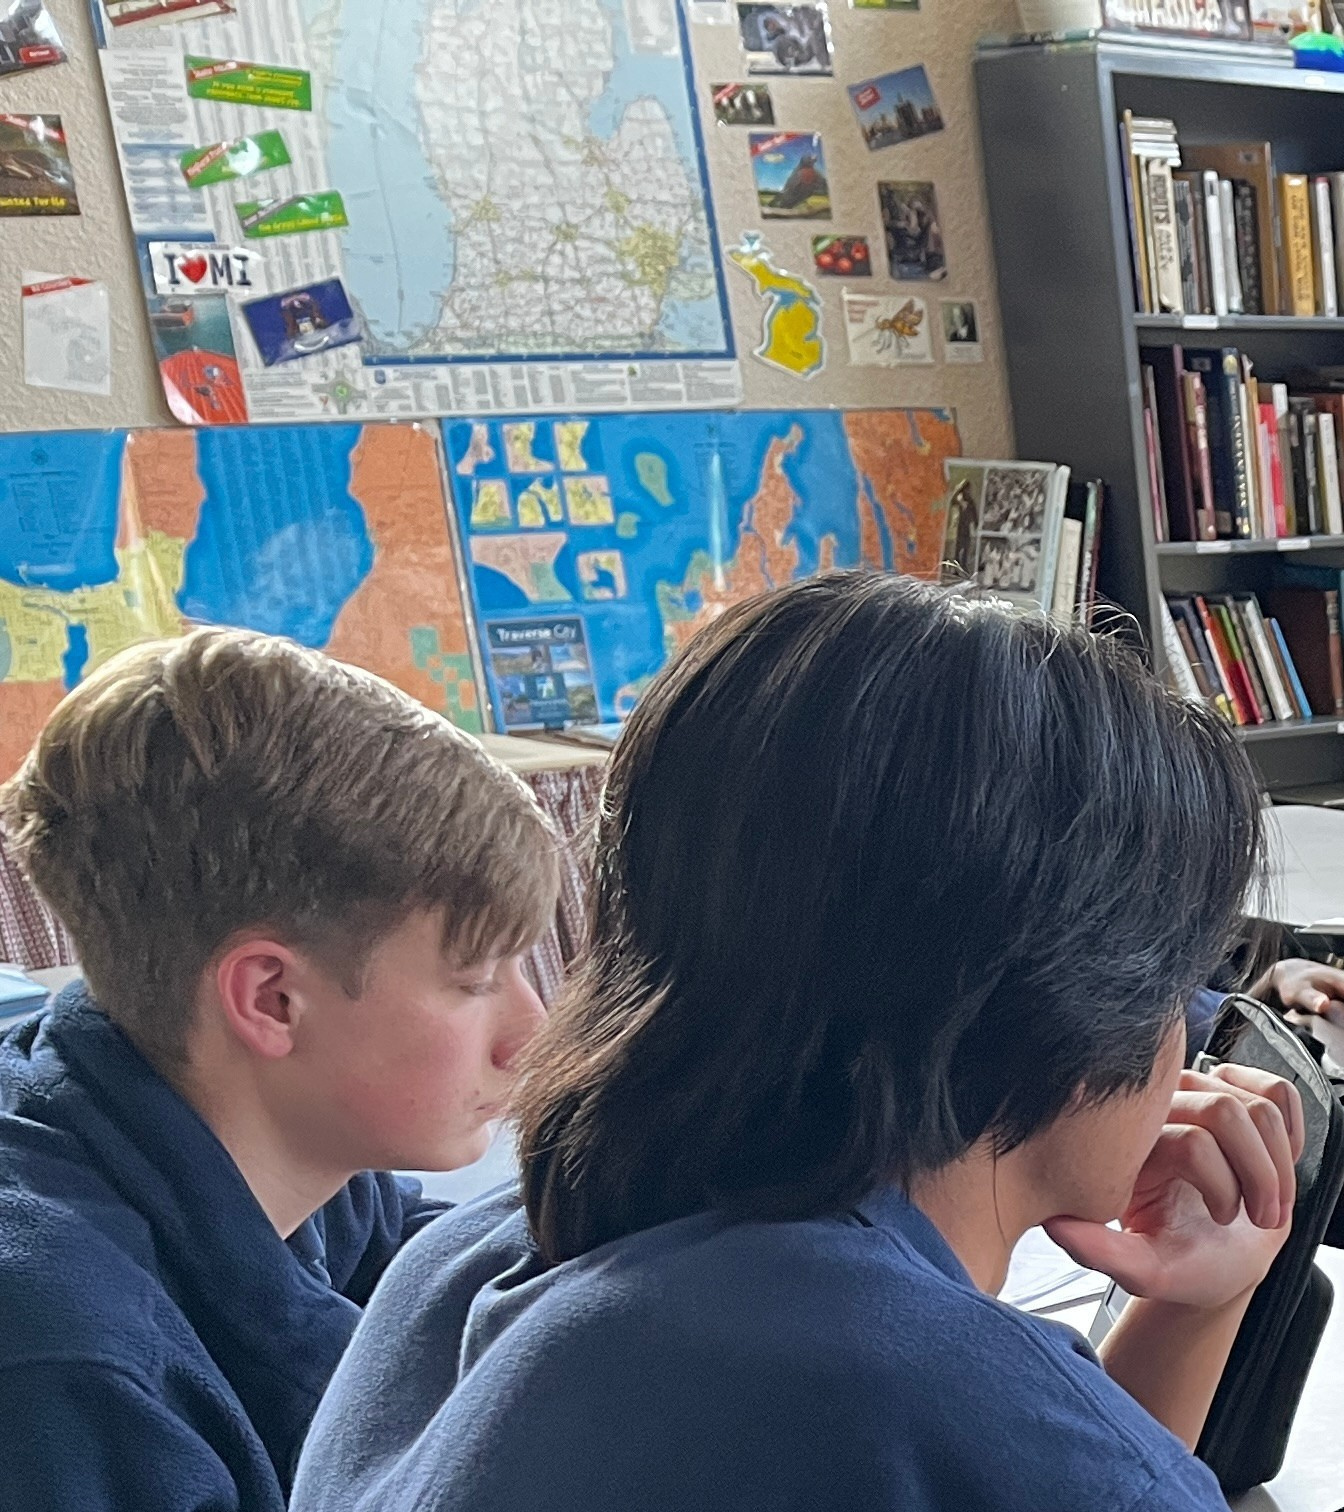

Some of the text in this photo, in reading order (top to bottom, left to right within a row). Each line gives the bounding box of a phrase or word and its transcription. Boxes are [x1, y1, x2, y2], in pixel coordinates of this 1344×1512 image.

[163, 253, 252, 286] I MI
[497, 622, 578, 643] Traverse City
